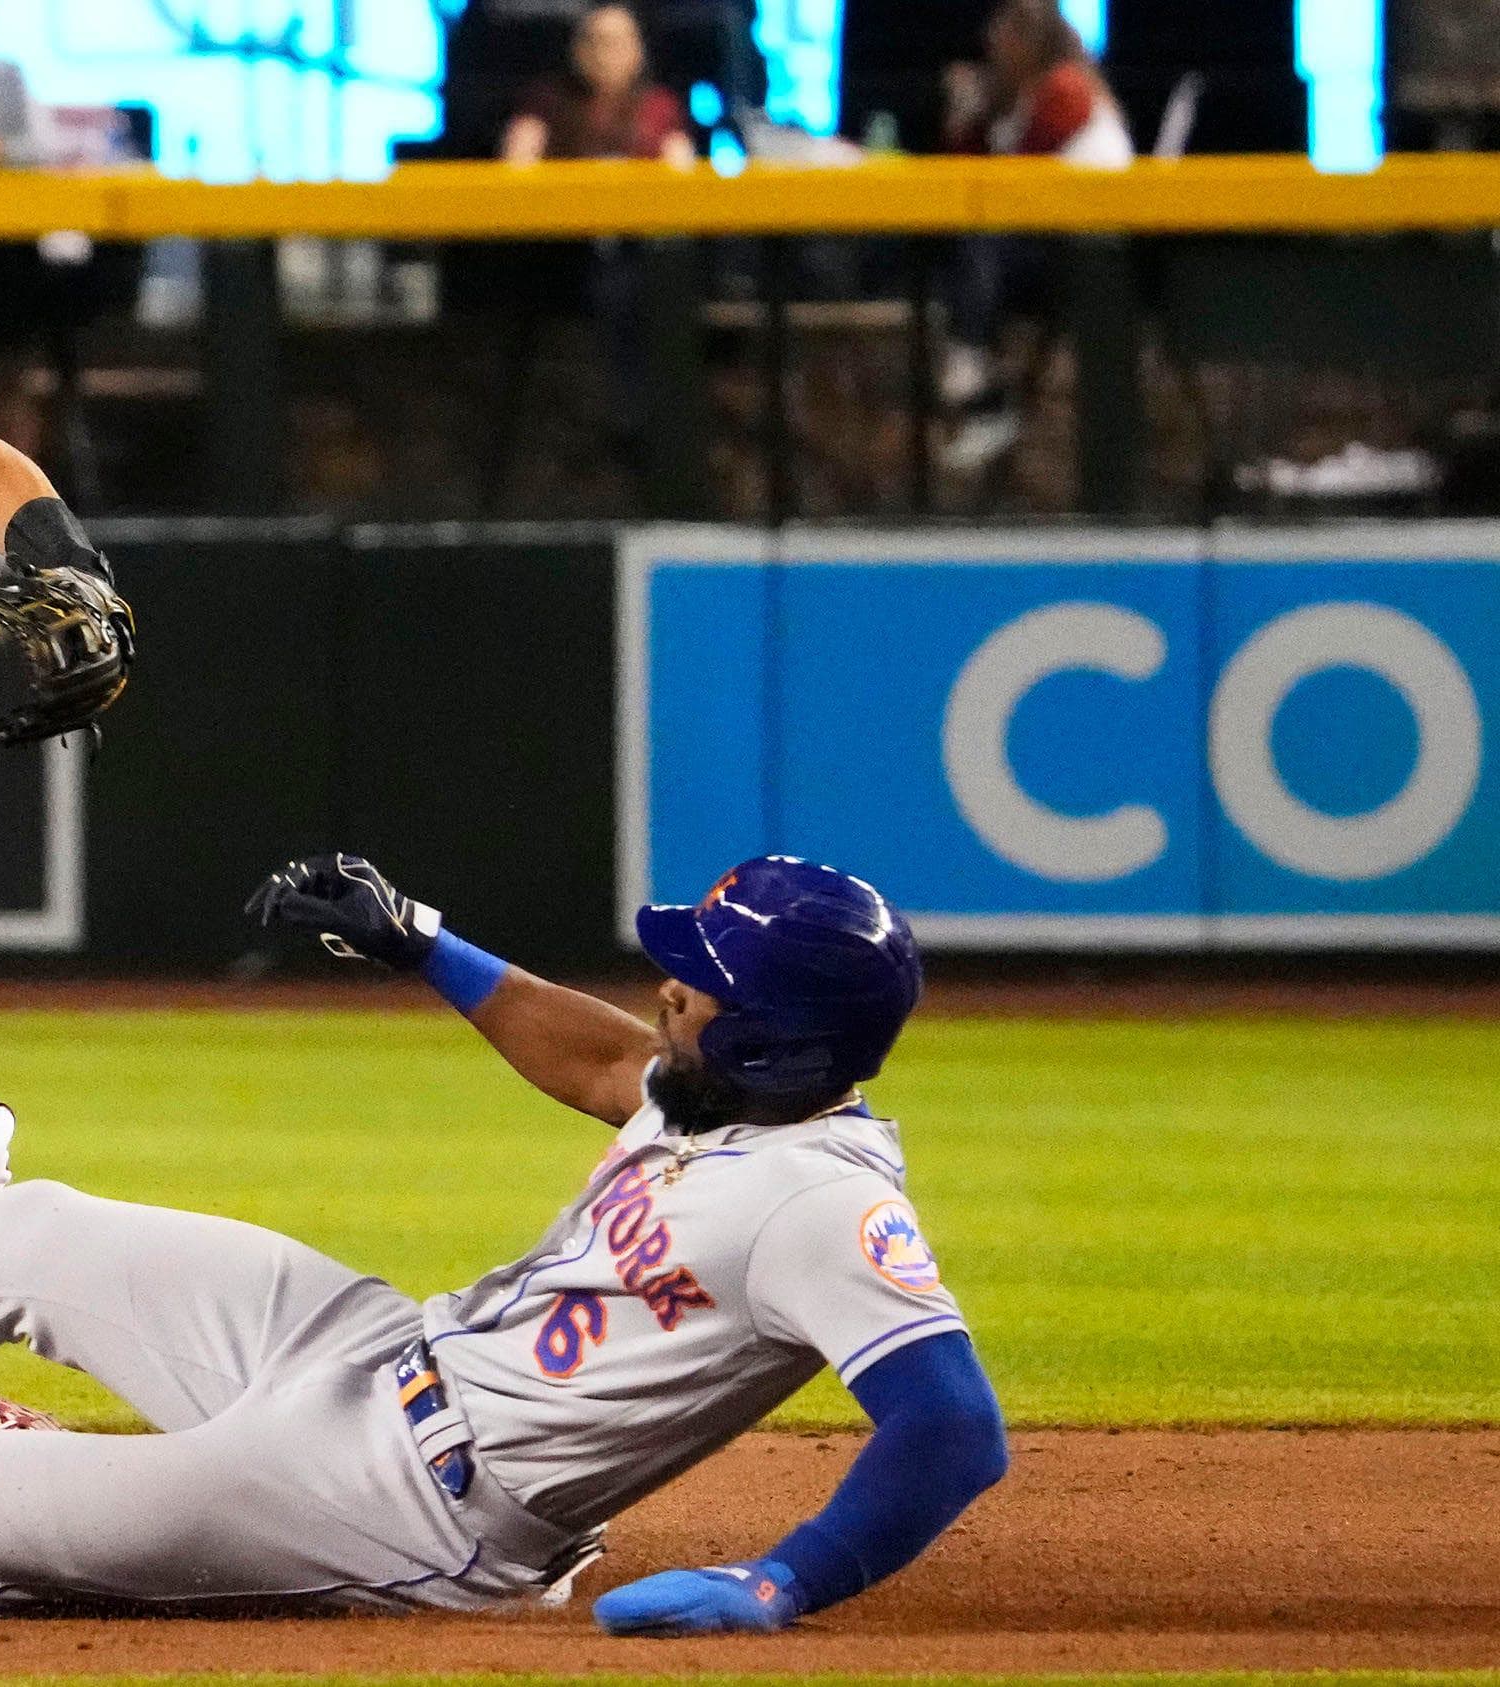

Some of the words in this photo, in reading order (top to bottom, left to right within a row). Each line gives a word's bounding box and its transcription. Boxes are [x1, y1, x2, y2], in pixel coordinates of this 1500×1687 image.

[942, 600, 1482, 882] CO
[591, 1160, 716, 1332] YORK
[533, 1289, 607, 1379] 6
